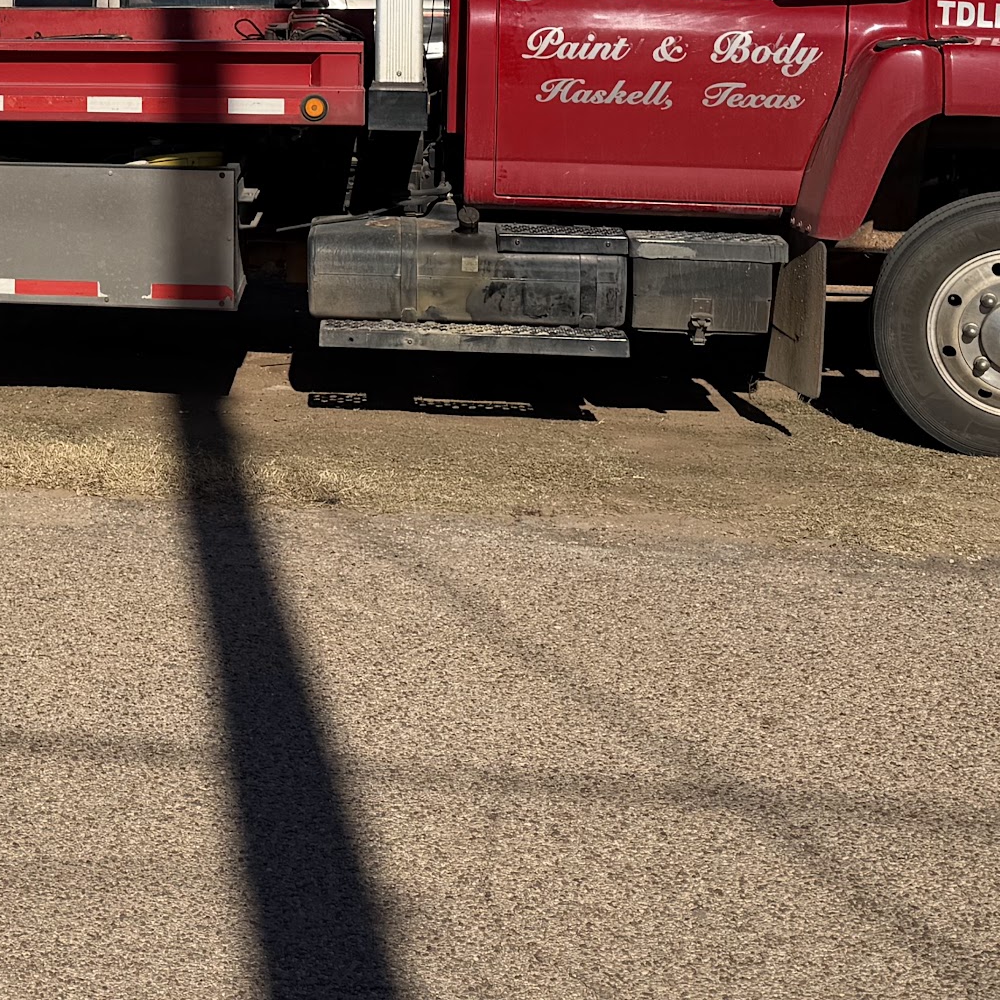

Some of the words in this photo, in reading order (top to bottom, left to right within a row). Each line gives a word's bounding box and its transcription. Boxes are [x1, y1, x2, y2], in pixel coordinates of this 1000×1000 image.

[521, 26, 632, 62] Paint
[652, 35, 688, 63] &
[709, 30, 824, 78] Body
[535, 77, 674, 111] Haskell,
[701, 82, 807, 110] Texas
